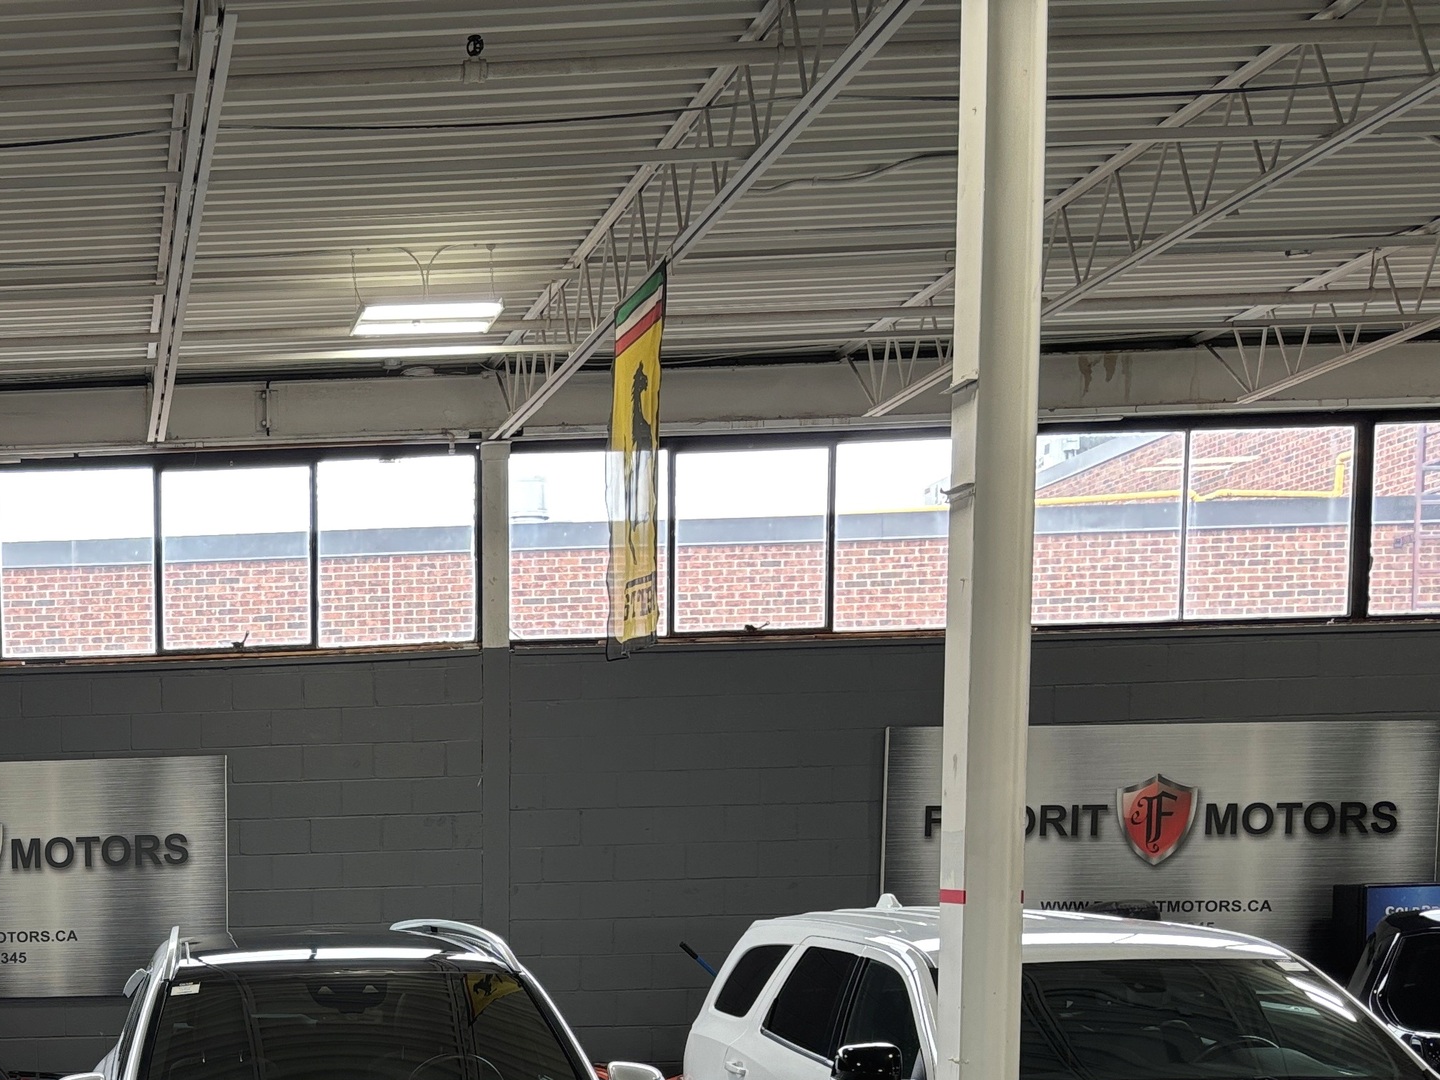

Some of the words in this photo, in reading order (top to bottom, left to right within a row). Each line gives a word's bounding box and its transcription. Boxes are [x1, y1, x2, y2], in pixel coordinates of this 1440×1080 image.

[924, 804, 1109, 837] FRIT
[1205, 801, 1398, 836] MOTORS
[11, 833, 189, 870] MOTORS
[1040, 900, 1273, 913] WWWTMOTORS.CA
